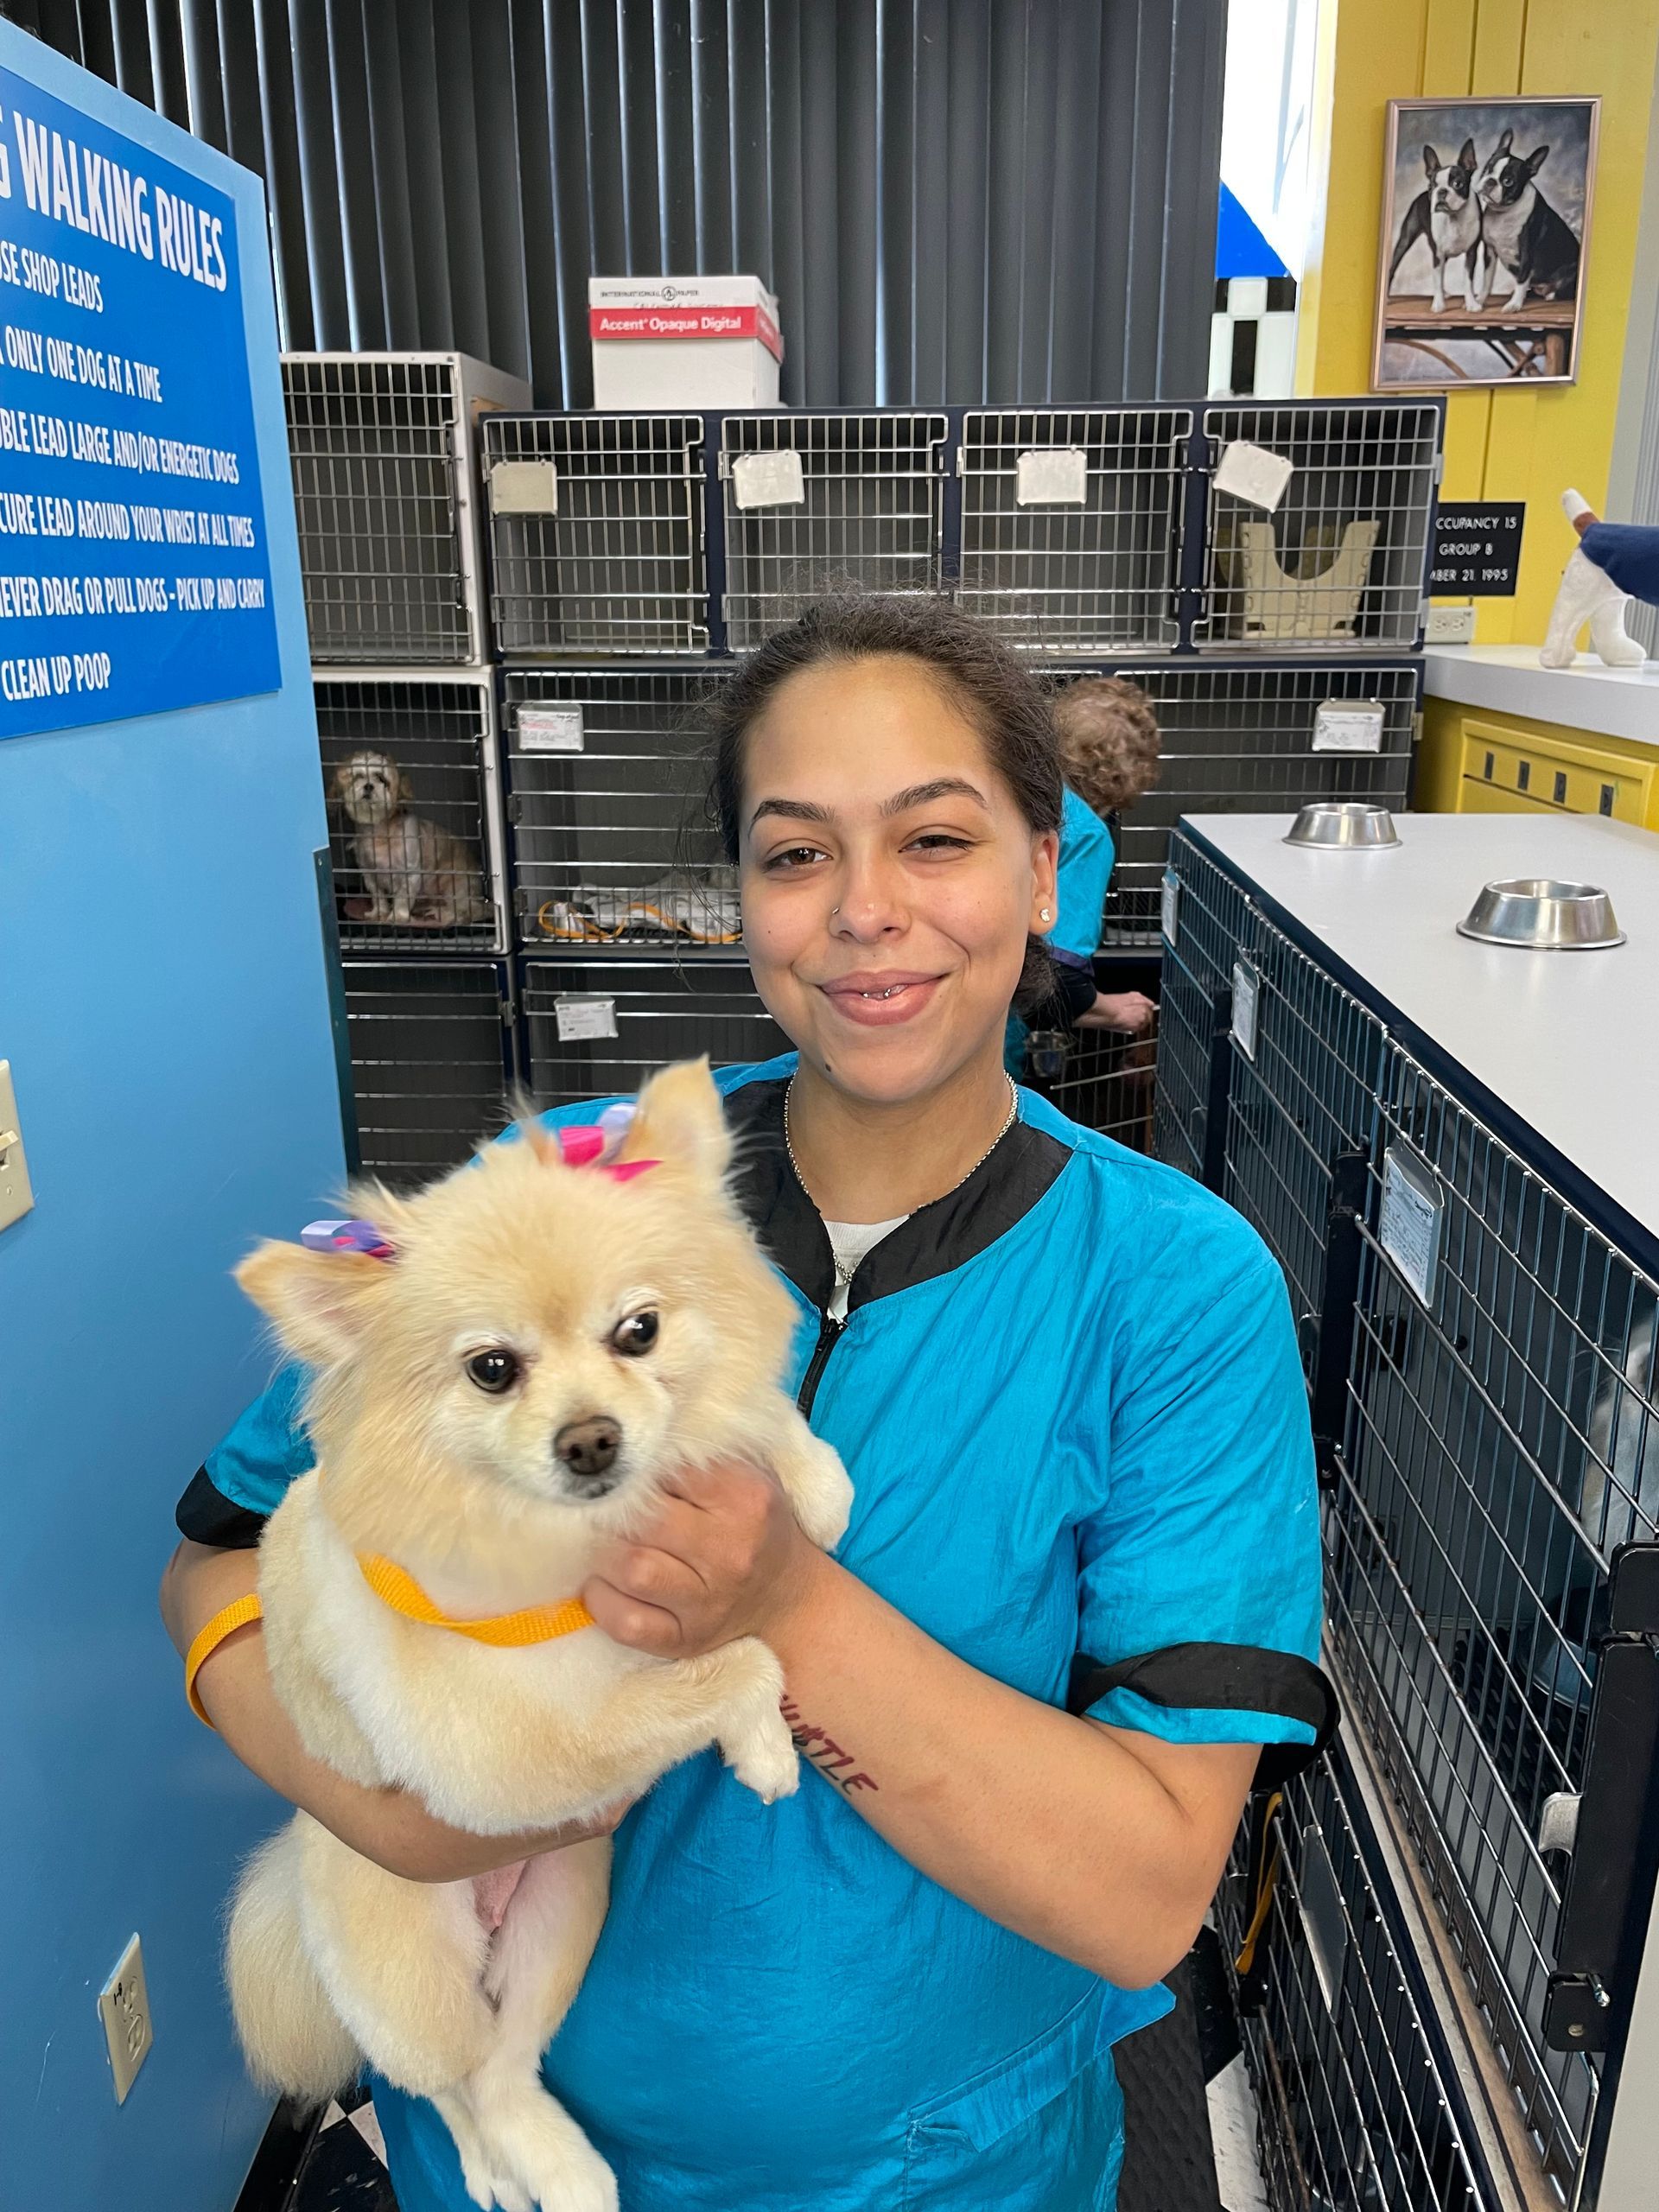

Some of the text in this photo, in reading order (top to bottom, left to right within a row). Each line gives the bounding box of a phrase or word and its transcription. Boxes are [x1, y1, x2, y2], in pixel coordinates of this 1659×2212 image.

[13, 110, 154, 261] WALKING
[155, 185, 227, 292] RULES
[0, 240, 104, 314] SE SHOP LEADS
[649, 317, 699, 333] Opaque
[701, 315, 742, 332] Digital
[5, 325, 44, 374] ONLY
[46, 336, 77, 383] ONE
[76, 344, 107, 390] DOG
[108, 353, 124, 393] AT
[124, 359, 136, 397] A
[133, 361, 162, 404] TIME
[30, 413, 68, 458] LEAD
[68, 420, 112, 465] LARGE
[113, 429, 160, 474] AND/OR
[158, 438, 214, 481] ENERGETIC
[213, 448, 239, 485] DOGS
[37, 495, 75, 537] LEAD
[77, 499, 130, 541] AROUND
[130, 505, 164, 543] YOUR
[162, 508, 197, 544] WRIST
[198, 512, 210, 545] AT
[212, 513, 229, 547] ALL
[227, 515, 255, 548] TIMES
[1439, 543, 1493, 556] GROUP B
[1482, 568, 1509, 582] 1995
[41, 576, 84, 616] DRAG
[84, 576, 105, 615] OR
[105, 577, 137, 614] PULL
[135, 577, 168, 613] DOGS
[175, 577, 202, 612] PICK
[200, 577, 216, 611] UP
[216, 578, 237, 611] AND
[237, 578, 265, 609] CARRY
[1, 652, 111, 702] CLEAN UP POOP
